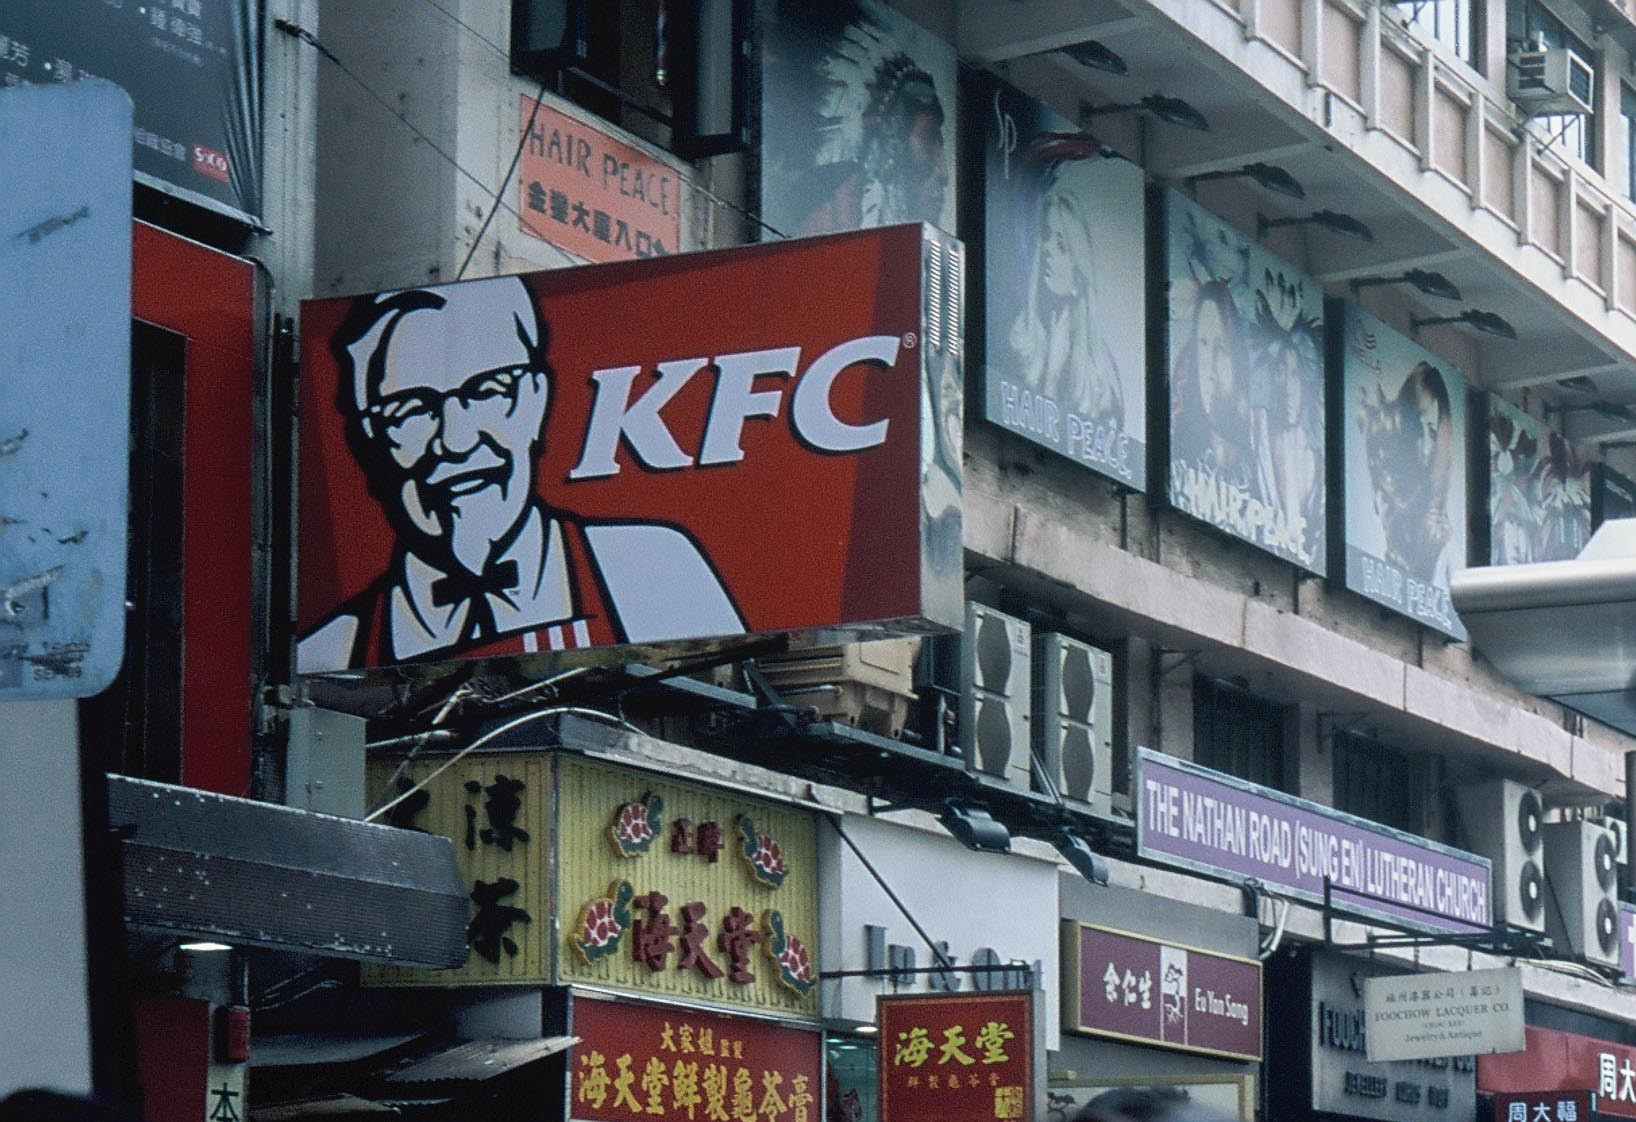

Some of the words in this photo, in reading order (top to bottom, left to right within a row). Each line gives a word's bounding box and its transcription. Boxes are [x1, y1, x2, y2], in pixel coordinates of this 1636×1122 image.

[529, 120, 592, 178] HAIR
[602, 153, 672, 217] PEACE
[568, 334, 902, 484] KFC
[999, 381, 1061, 444] HAIR
[1065, 413, 1133, 481] PEACE
[1361, 556, 1403, 605] HAIR
[1146, 779, 1180, 838] THE
[1182, 791, 1247, 857] NATHAN
[1251, 812, 1292, 869] ROAD
[1294, 820, 1338, 882] (SUNG
[1340, 838, 1365, 893] EN)
[1366, 847, 1434, 910] LUTHERAN
[1435, 867, 1487, 924] CHURCH
[632, 890, 764, 984] 海天堂
[894, 1020, 1015, 1069] 海天堂
[1194, 987, 1207, 1013] Eu
[1207, 989, 1225, 1016] Yan
[1225, 993, 1249, 1026] Sang
[1374, 1007, 1431, 1022] FOOCHOW
[1435, 1003, 1489, 1018] LACQUER
